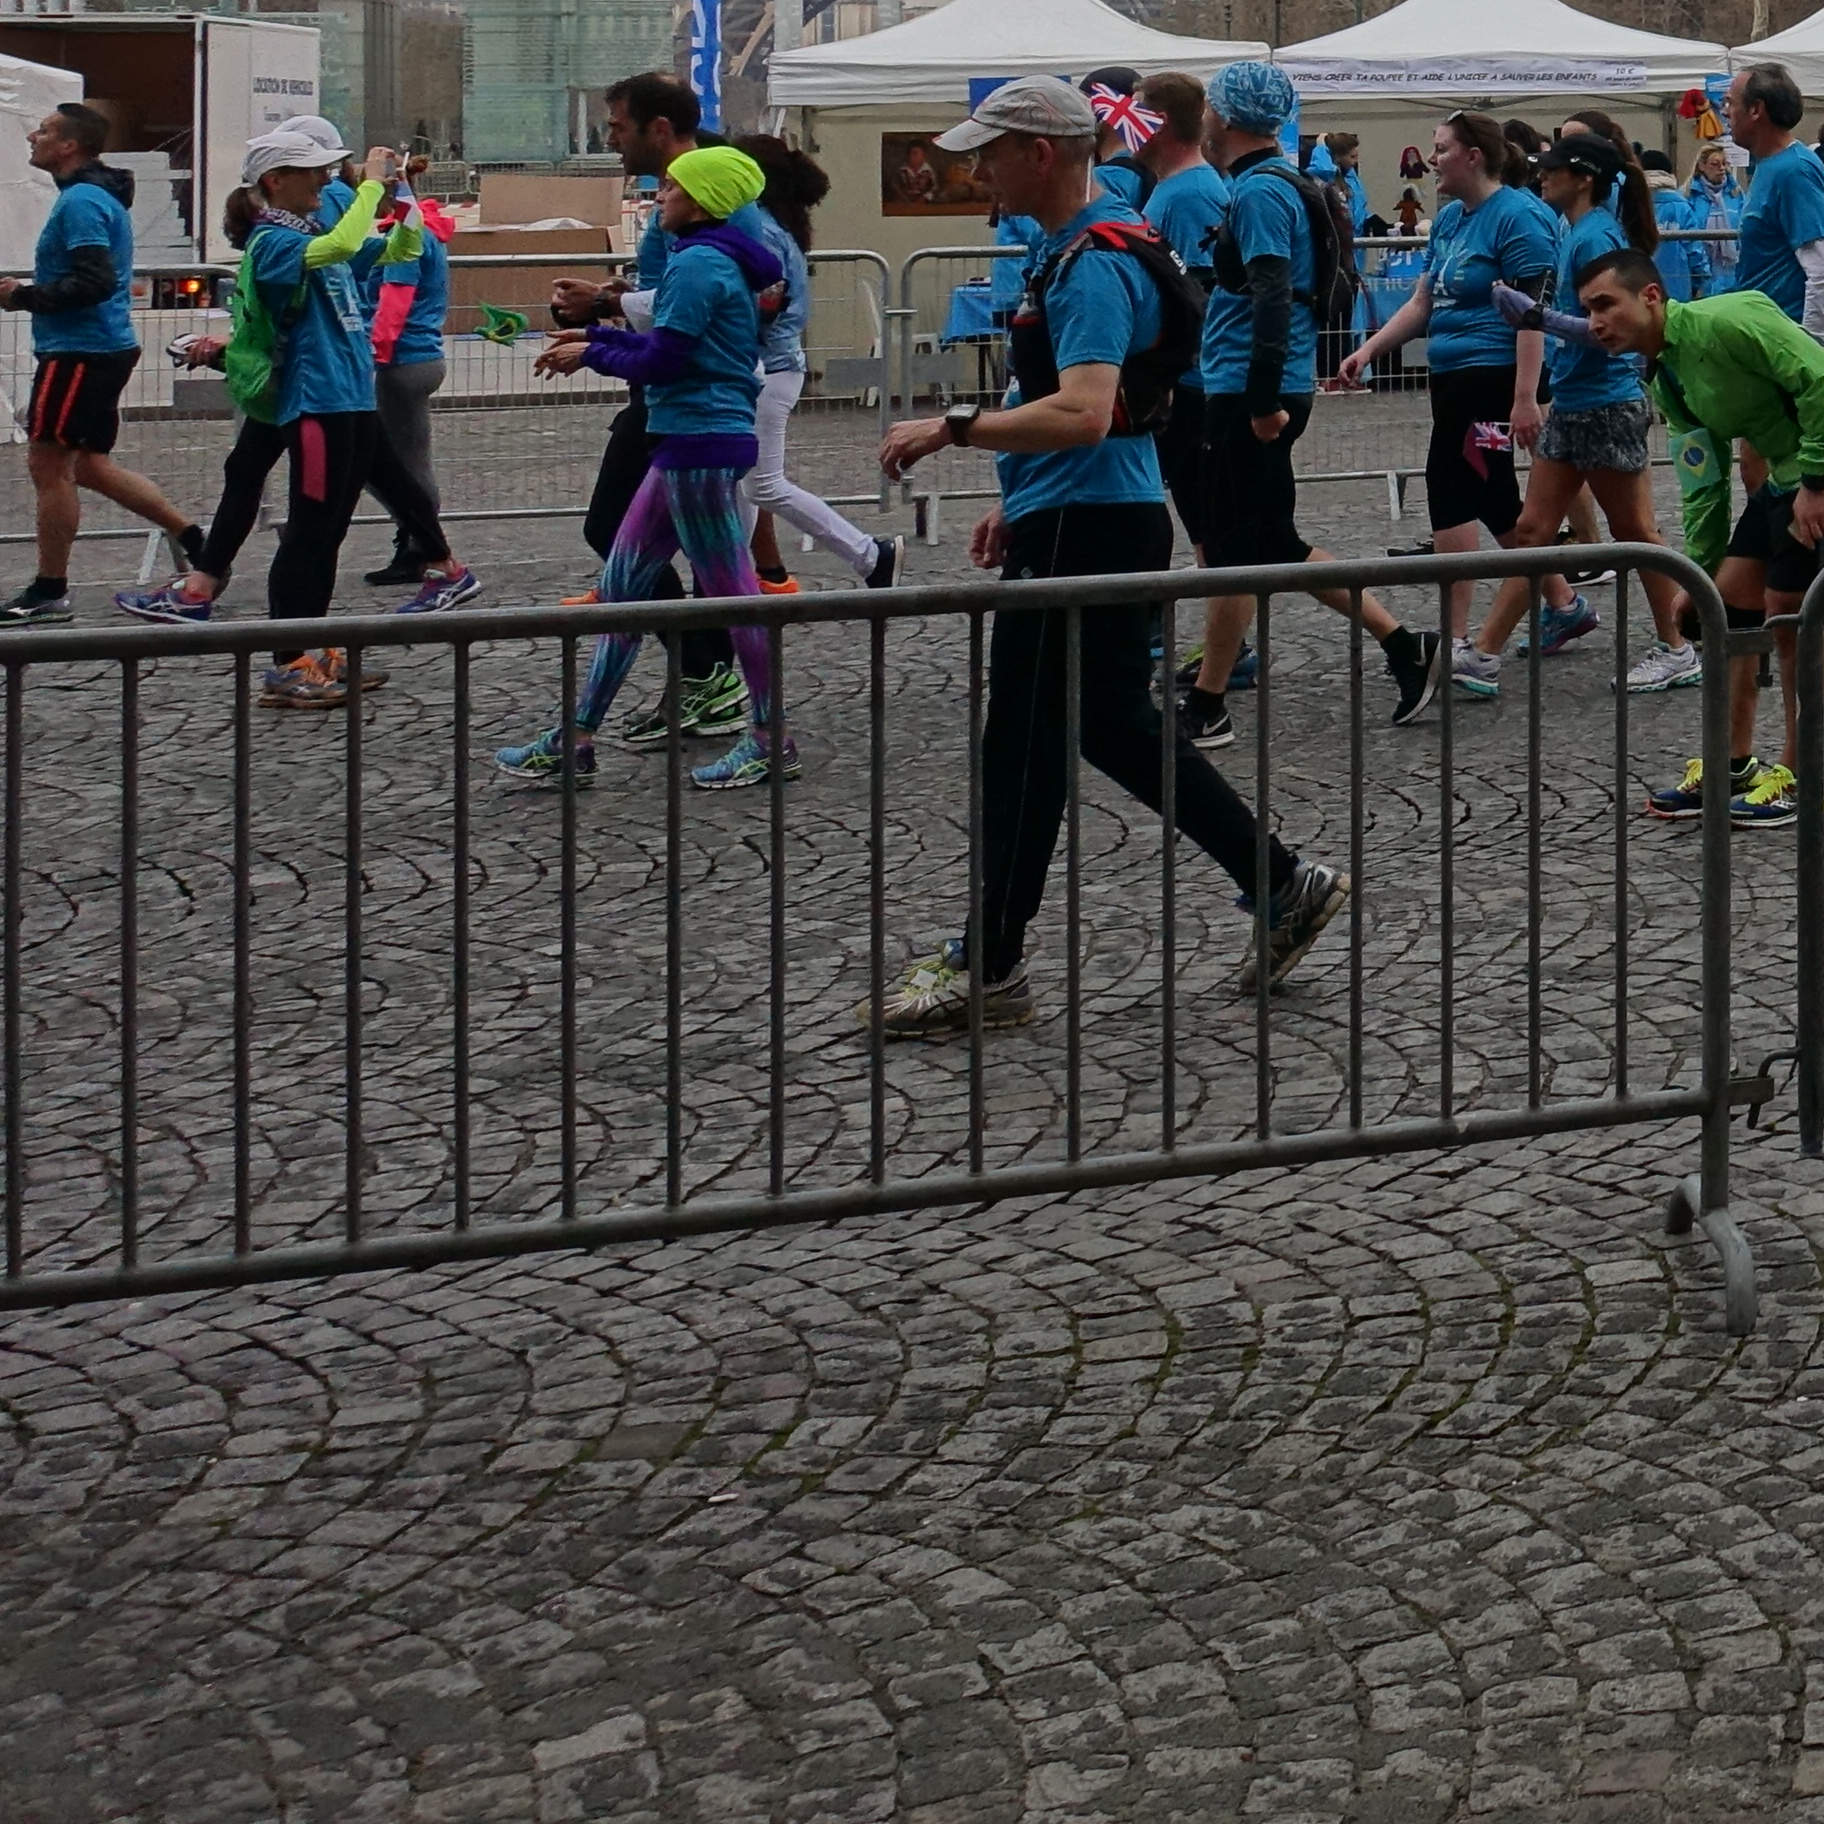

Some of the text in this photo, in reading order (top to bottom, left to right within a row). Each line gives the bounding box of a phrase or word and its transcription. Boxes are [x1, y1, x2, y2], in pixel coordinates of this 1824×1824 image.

[1292, 73, 1322, 81] VIENS
[1356, 73, 1368, 81] TA
[1406, 73, 1419, 82] ET
[1422, 73, 1444, 81] AIDE
[1491, 73, 1498, 81] A
[1500, 73, 1535, 81] SAUVER
[1536, 73, 1552, 81] LES
[1555, 72, 1598, 81] ENFANTS
